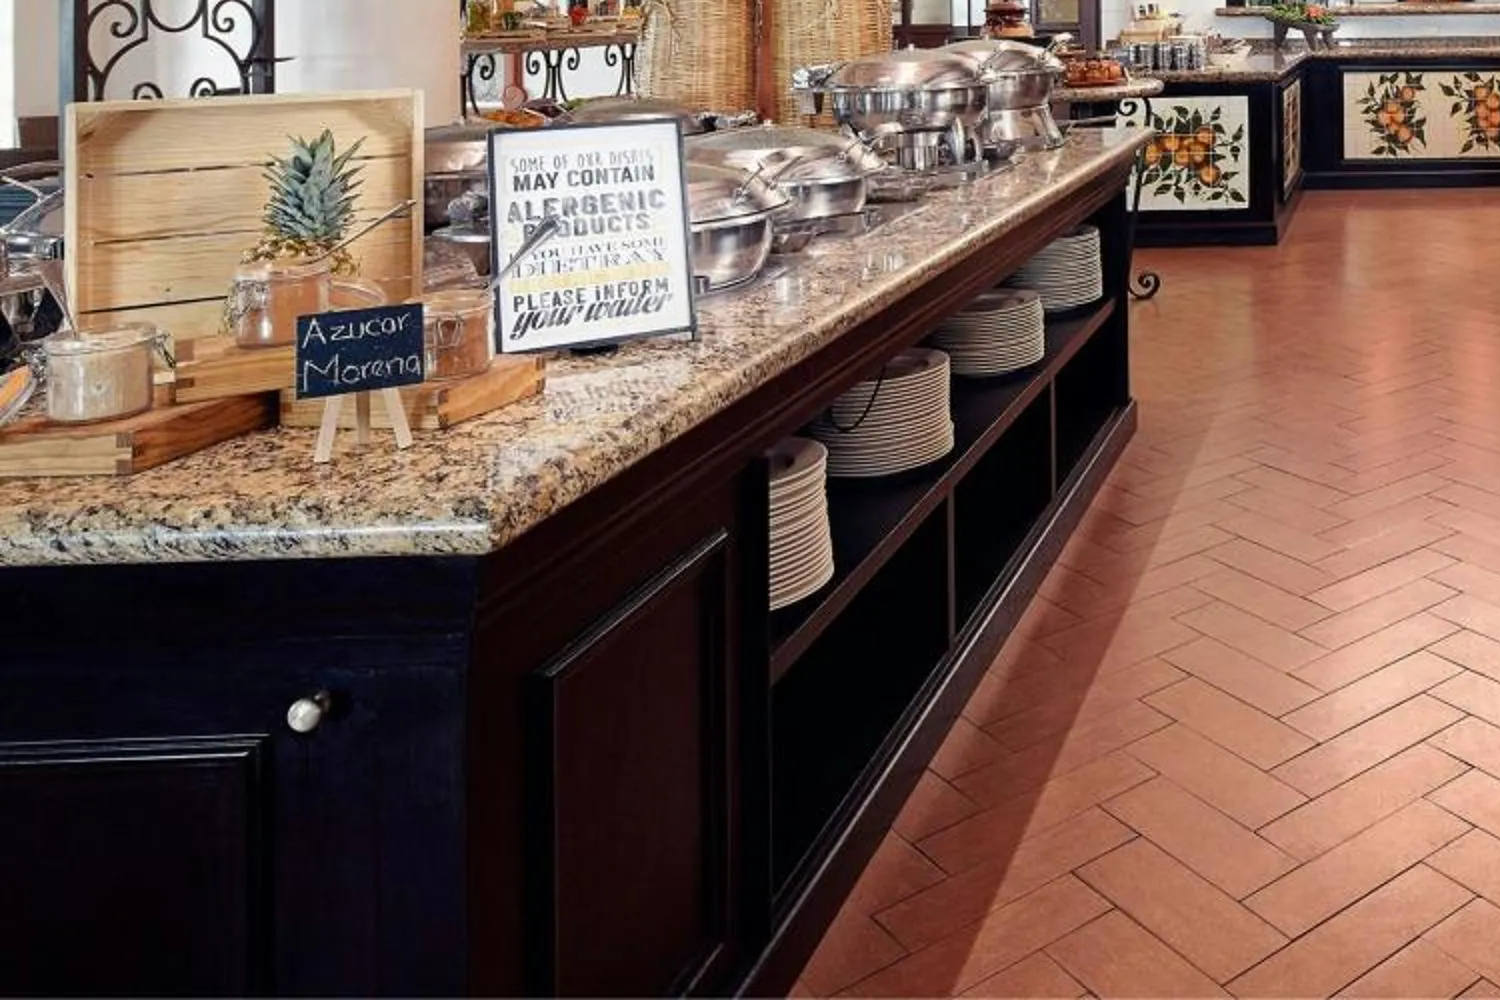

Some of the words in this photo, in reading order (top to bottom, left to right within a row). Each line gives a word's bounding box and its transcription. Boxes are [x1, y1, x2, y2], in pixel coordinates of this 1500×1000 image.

[511, 156, 545, 173] SOME
[513, 171, 559, 192] MAY
[567, 165, 656, 187] CONTAIN
[507, 189, 666, 224] ALERGENIC
[509, 304, 583, 341] your
[584, 291, 674, 323] waiter
[513, 287, 588, 312] PLEASE
[302, 312, 411, 349] Azucar
[303, 353, 421, 393] Morena
